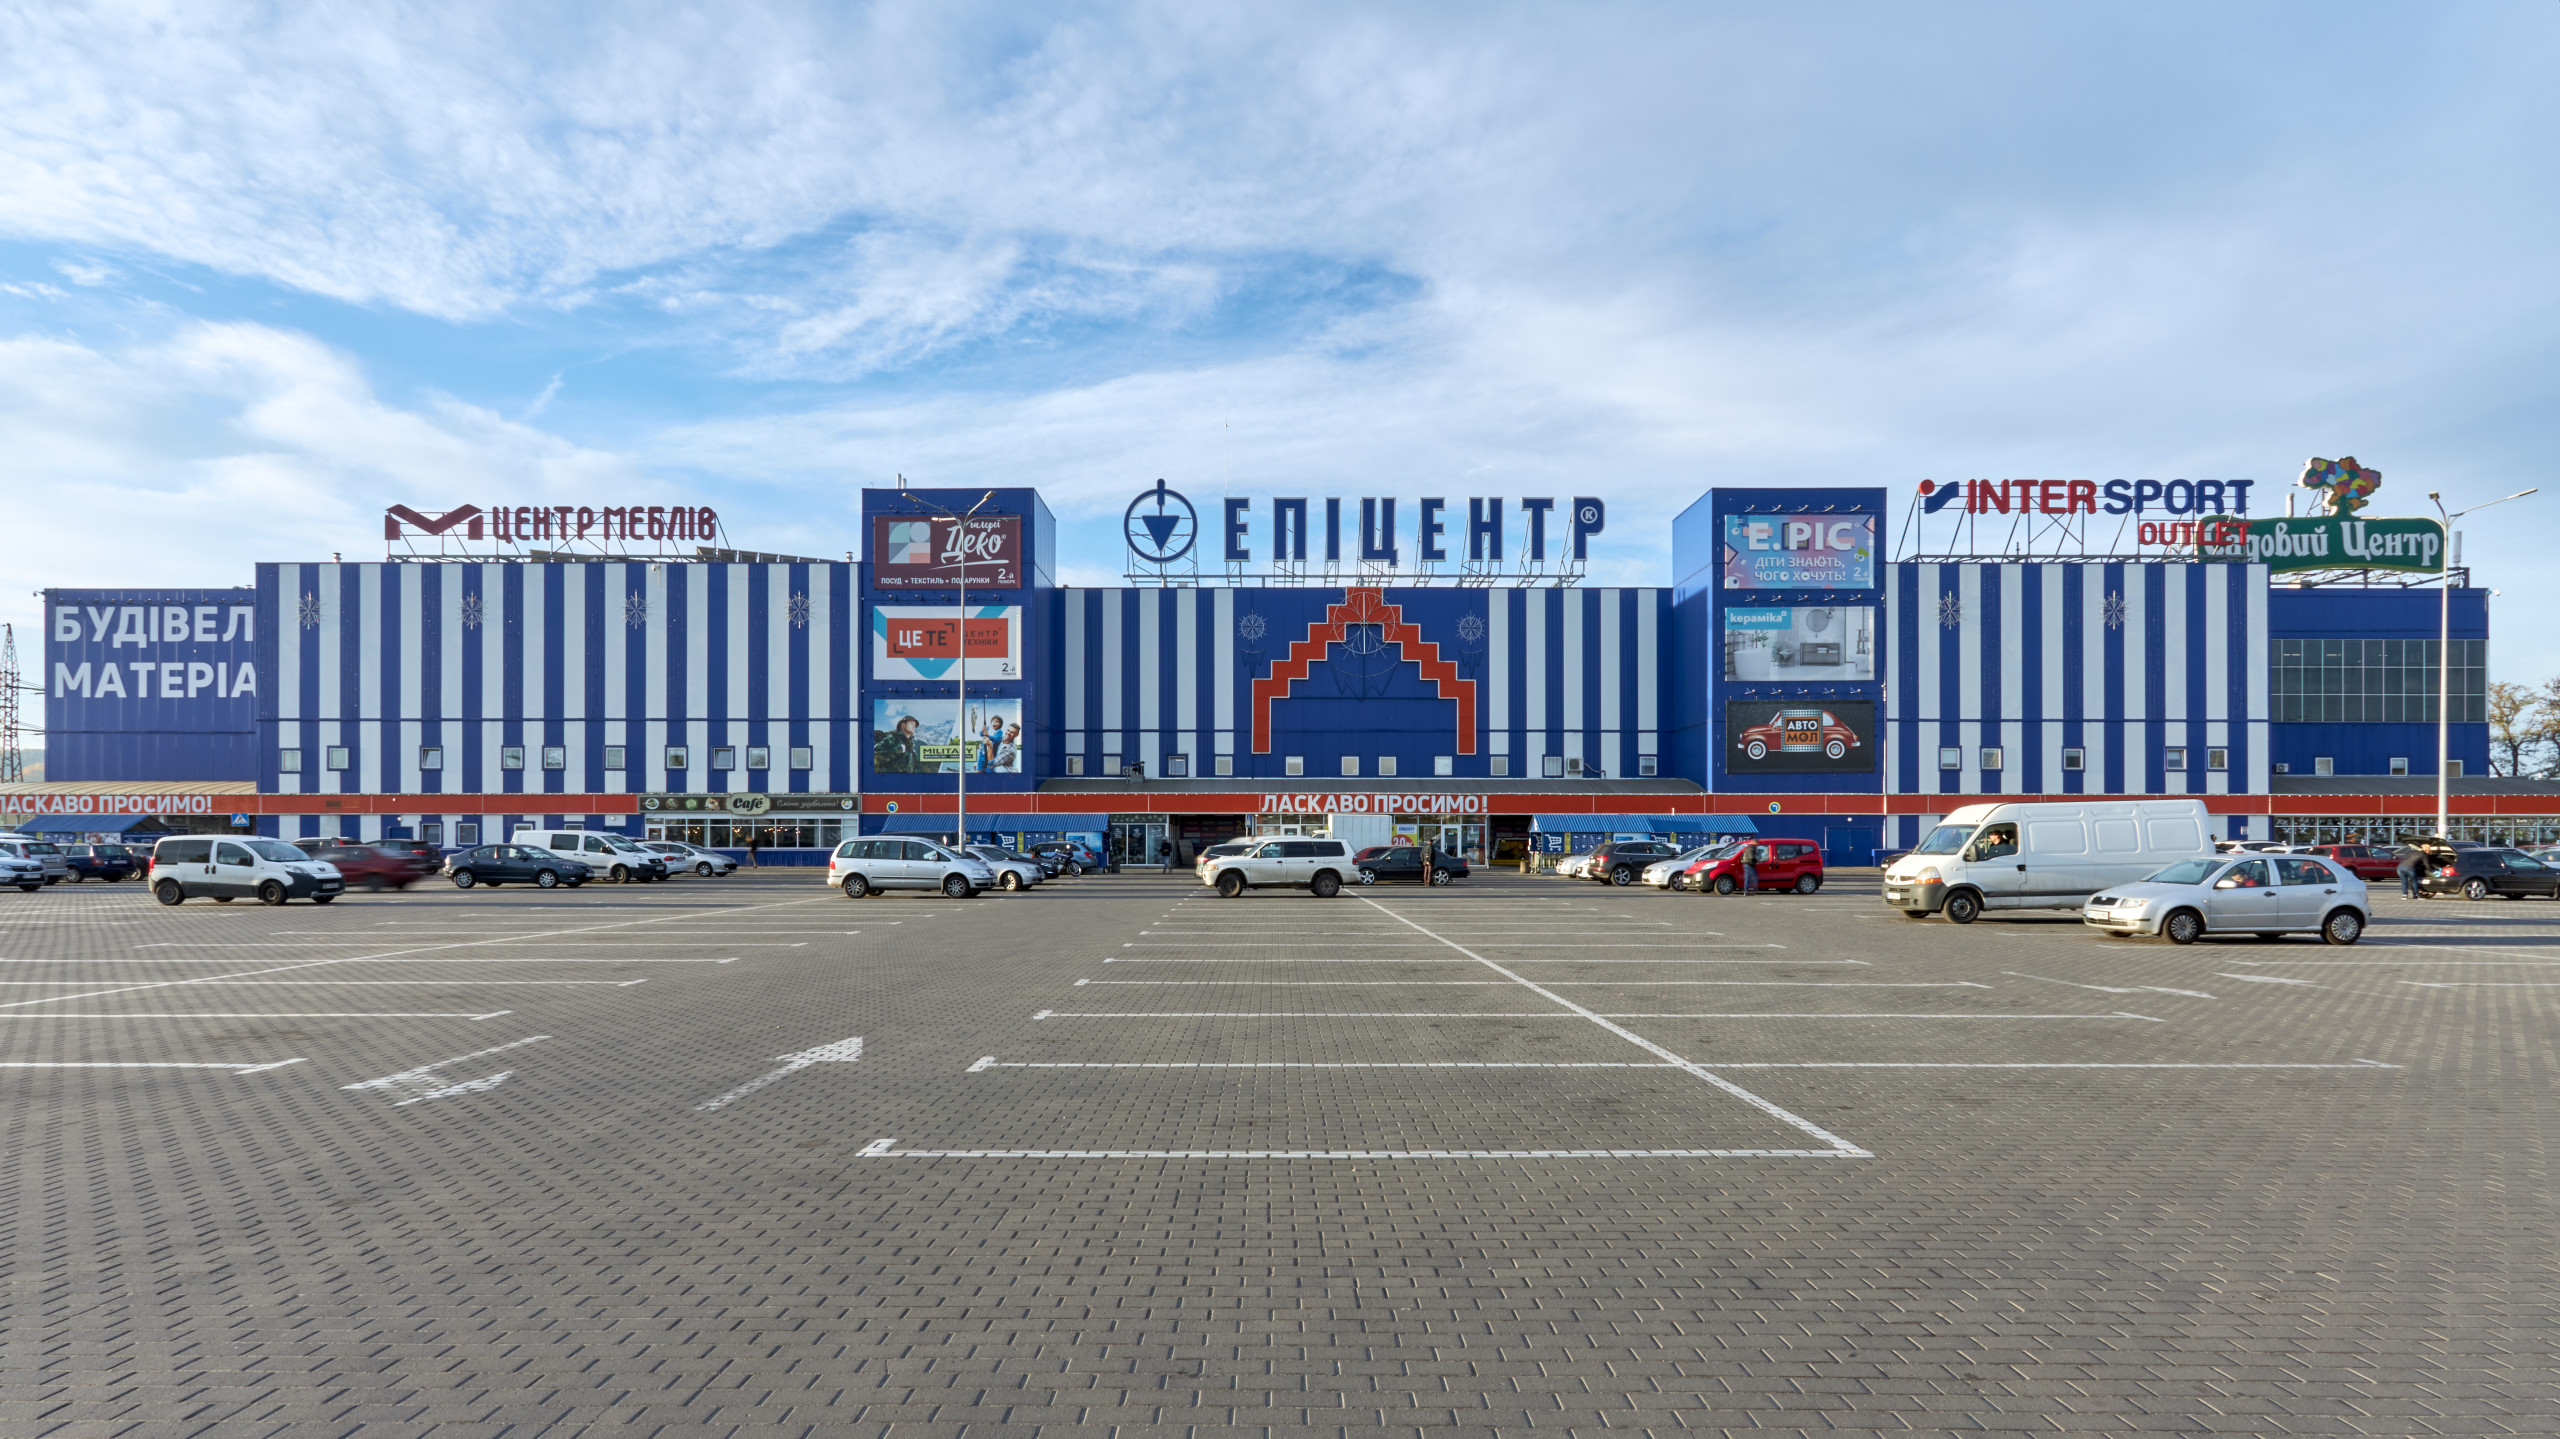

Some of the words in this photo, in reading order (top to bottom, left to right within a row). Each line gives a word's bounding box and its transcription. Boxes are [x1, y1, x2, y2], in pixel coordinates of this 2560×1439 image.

[492, 506, 594, 544] ЦЕНТР
[604, 506, 716, 541] МЕБЛІВ
[1224, 497, 1606, 568] ЕПІЦЕНТР
[2139, 521, 2253, 546] OUTLET
[1748, 522, 1853, 551] E.PIC
[2340, 521, 2439, 567] Центр
[1755, 557, 1785, 569] ДІТИ
[881, 577, 902, 585] ПОСУД
[1754, 571, 1790, 581] ЧОГО
[1792, 570, 1846, 582] ХОЧУТЬ!
[55, 605, 254, 649] БУДІВЕЛ
[55, 661, 256, 698] МАТЕРІА
[1787, 720, 1818, 731] АВТО
[1787, 732, 1818, 742] МОЛ
[98, 795, 213, 813] ПРОСИМО!
[732, 797, 764, 811] Café
[1262, 795, 1369, 813] ЛАСКАВО
[1374, 795, 1489, 813] ПРОСИМО!
